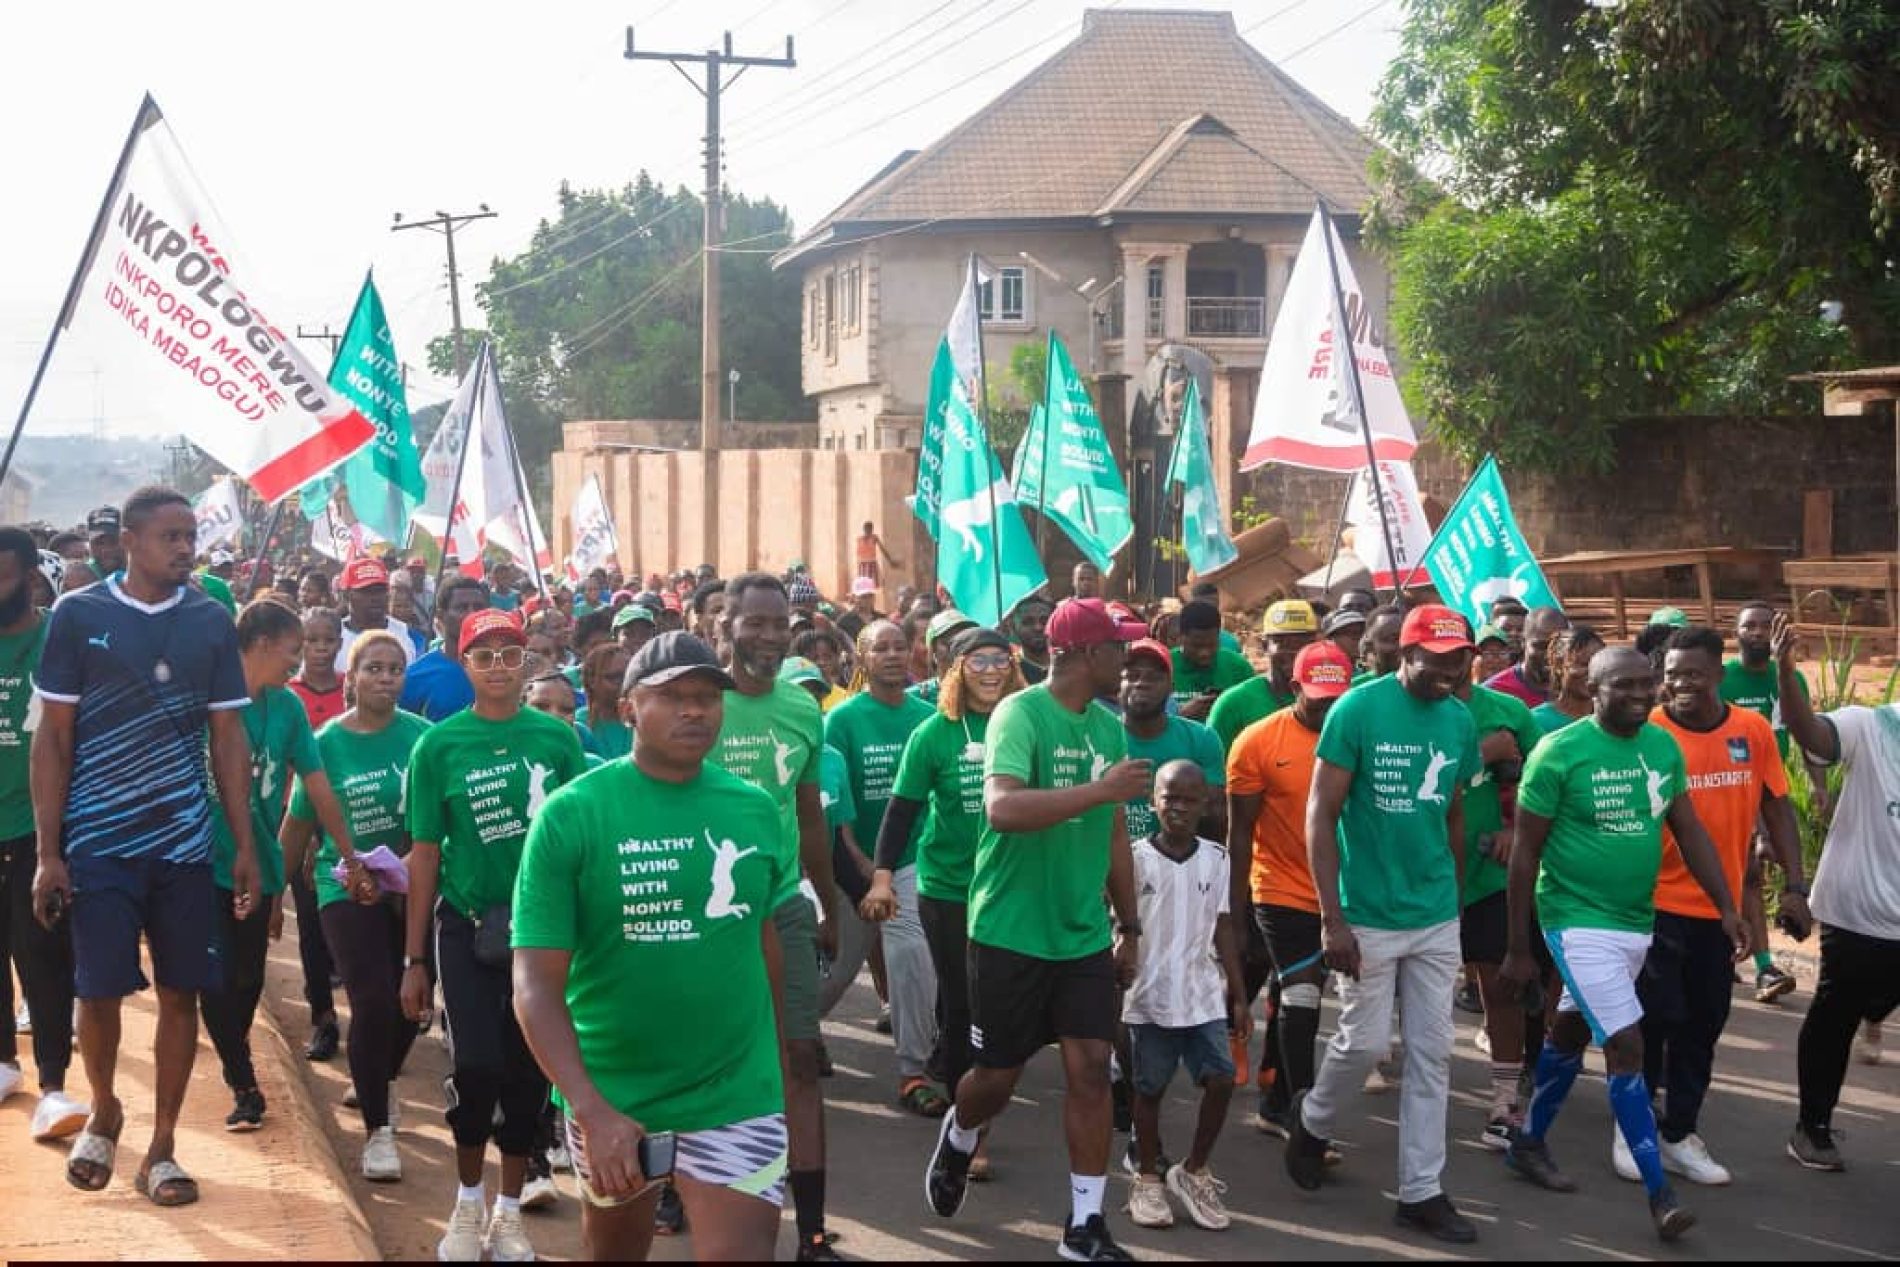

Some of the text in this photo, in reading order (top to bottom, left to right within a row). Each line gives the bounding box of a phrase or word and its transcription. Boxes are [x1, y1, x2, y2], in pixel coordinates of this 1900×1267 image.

[118, 192, 327, 413] NKPOLOGWU
[105, 281, 150, 339] IDIKA
[152, 327, 266, 421] MBAOGU)
[211, 336, 288, 413] MERE
[617, 837, 695, 856] HEALTHY
[621, 858, 680, 876] LIVING
[622, 880, 668, 897] WITH
[623, 899, 683, 916] NONYE
[623, 919, 693, 934] SOLUDO
